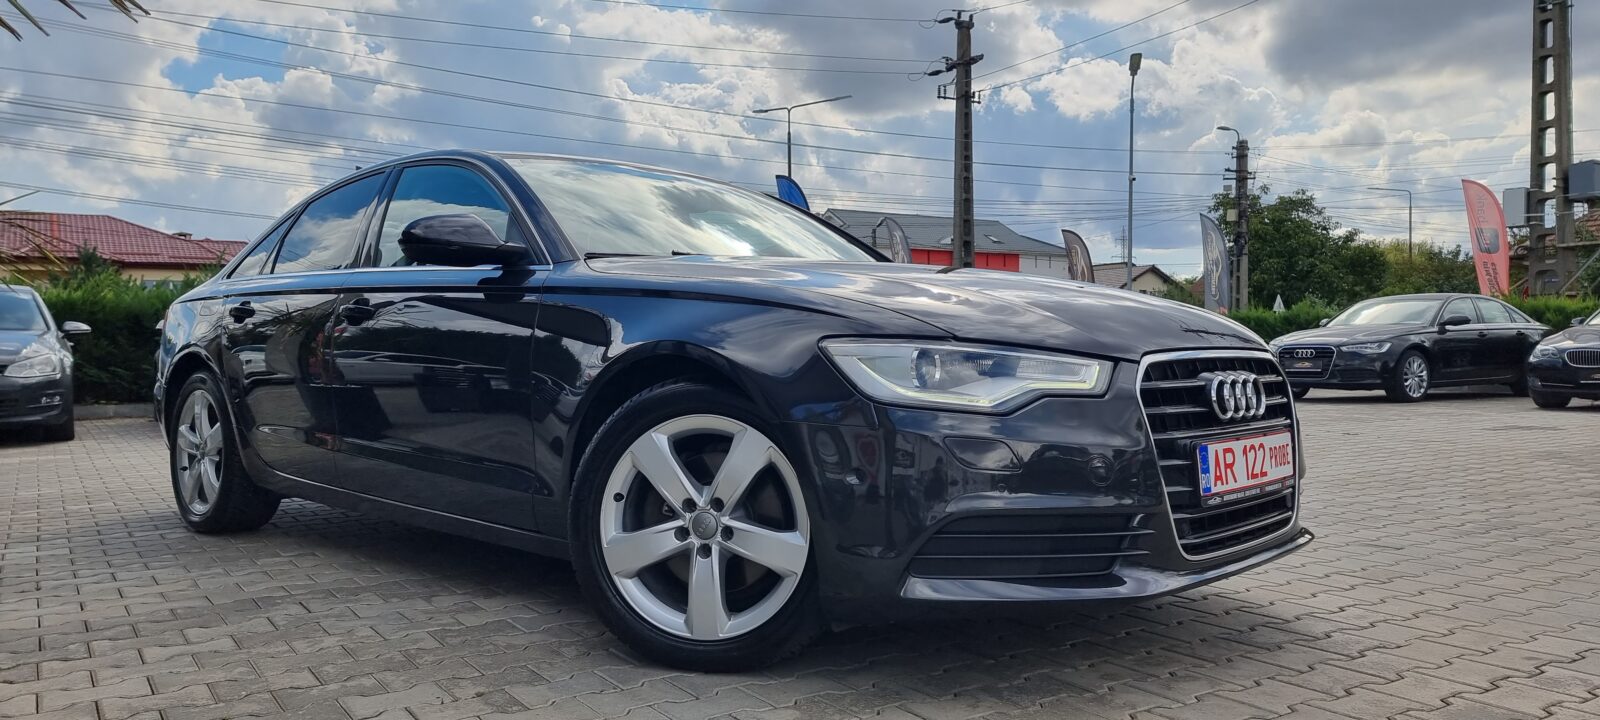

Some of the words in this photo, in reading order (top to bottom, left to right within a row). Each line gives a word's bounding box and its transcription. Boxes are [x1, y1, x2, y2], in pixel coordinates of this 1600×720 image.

[1214, 447, 1237, 487] AR
[1243, 443, 1268, 480] 122
[1269, 444, 1290, 469] PROBE
[1202, 474, 1211, 488] RO
